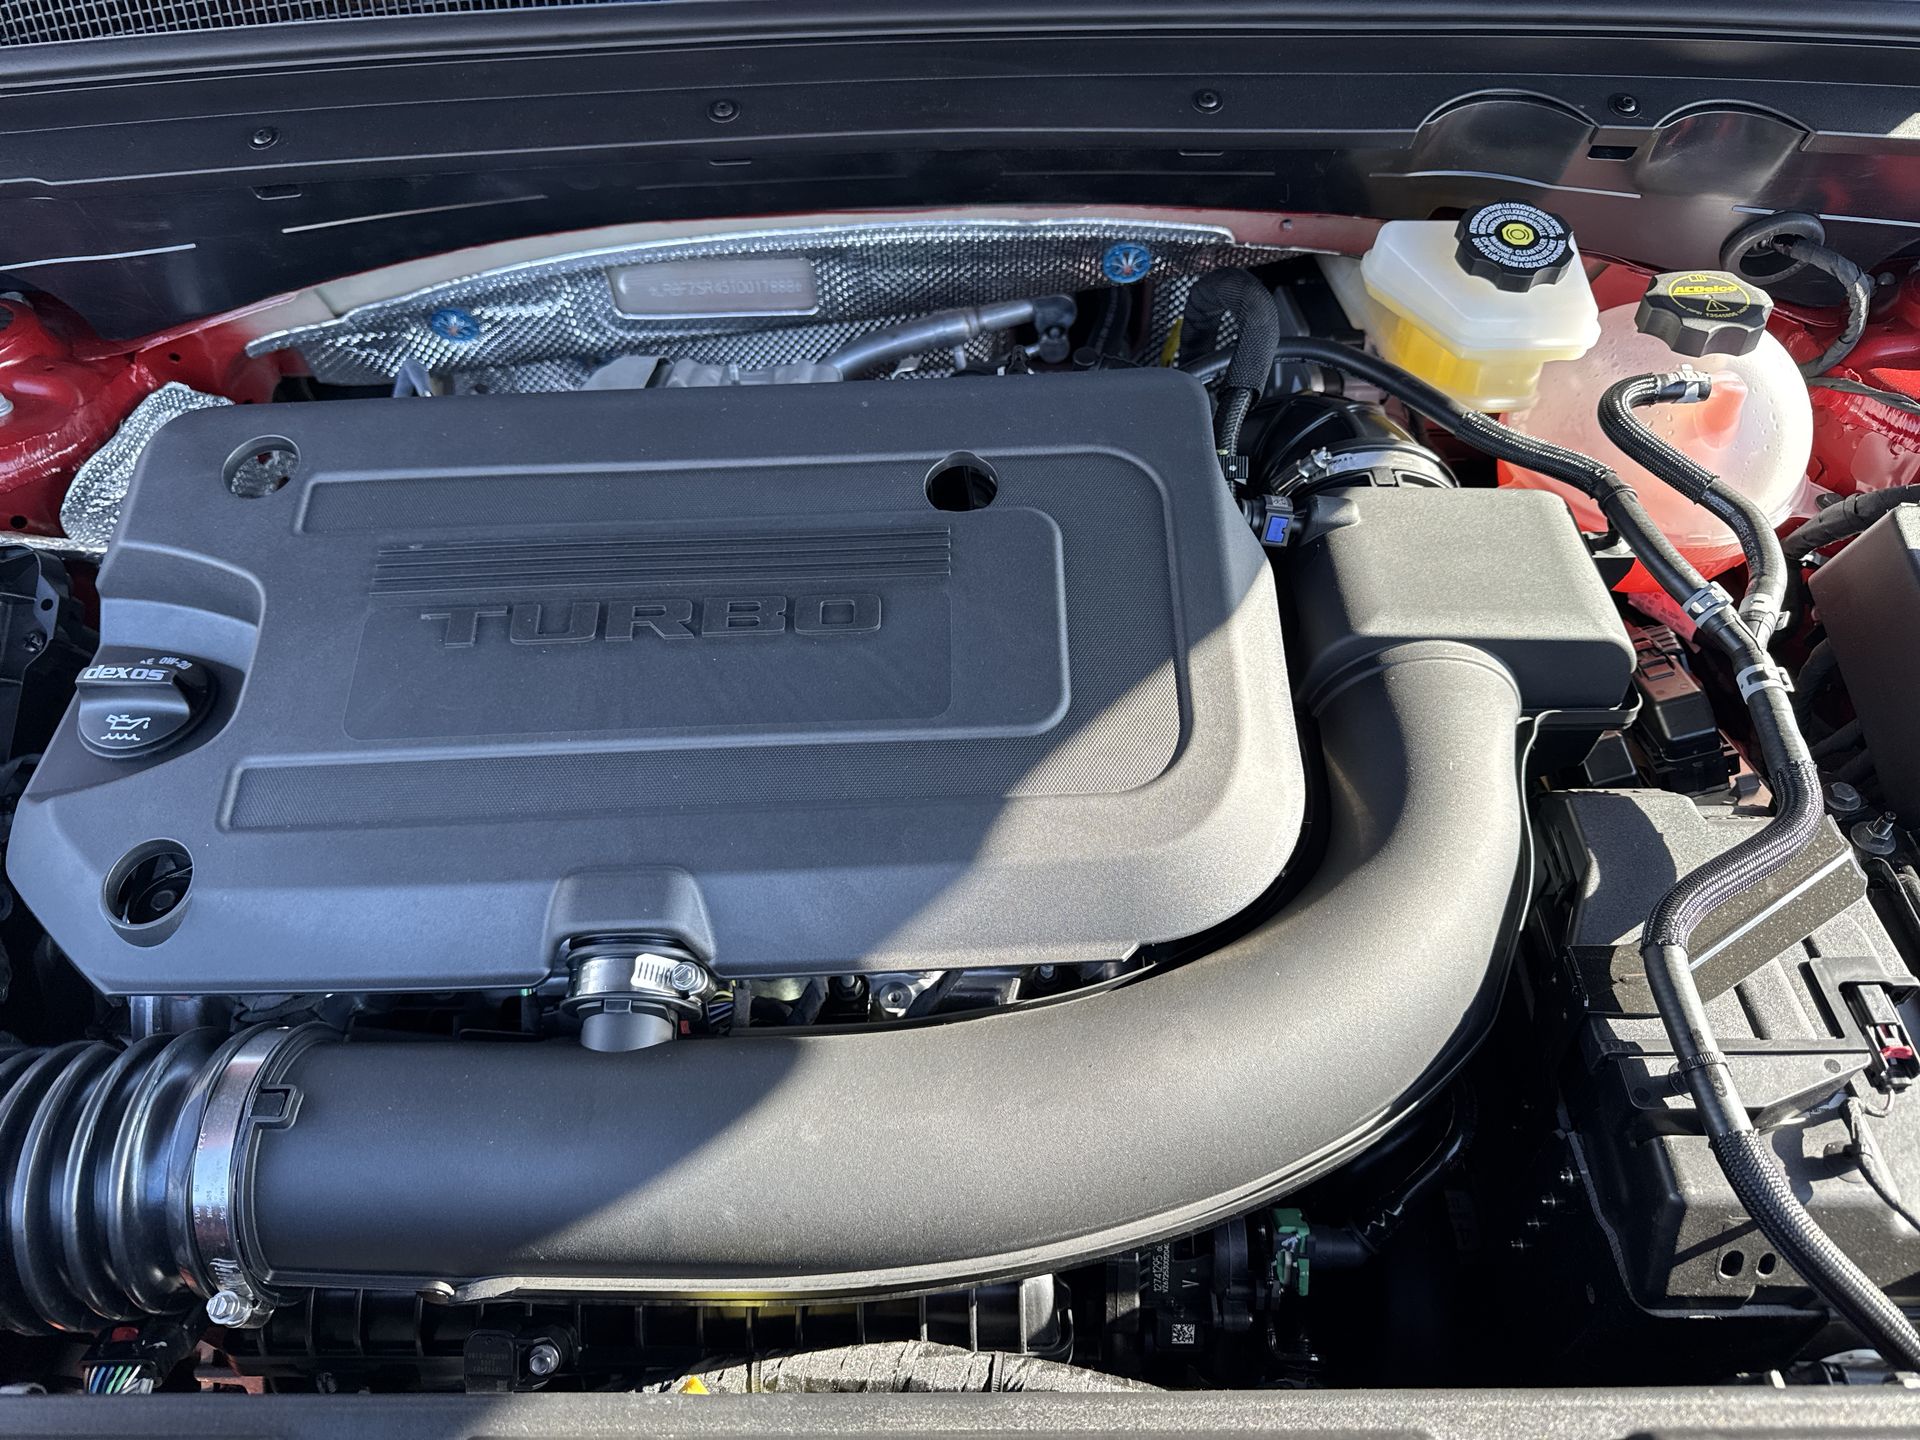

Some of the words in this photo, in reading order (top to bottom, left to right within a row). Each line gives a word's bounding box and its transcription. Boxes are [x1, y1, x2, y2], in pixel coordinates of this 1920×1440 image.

[1674, 286, 1737, 294] ACDelco
[420, 594, 882, 648] TURBO
[159, 656, 193, 670] 0W-20
[83, 665, 170, 681] dexos
